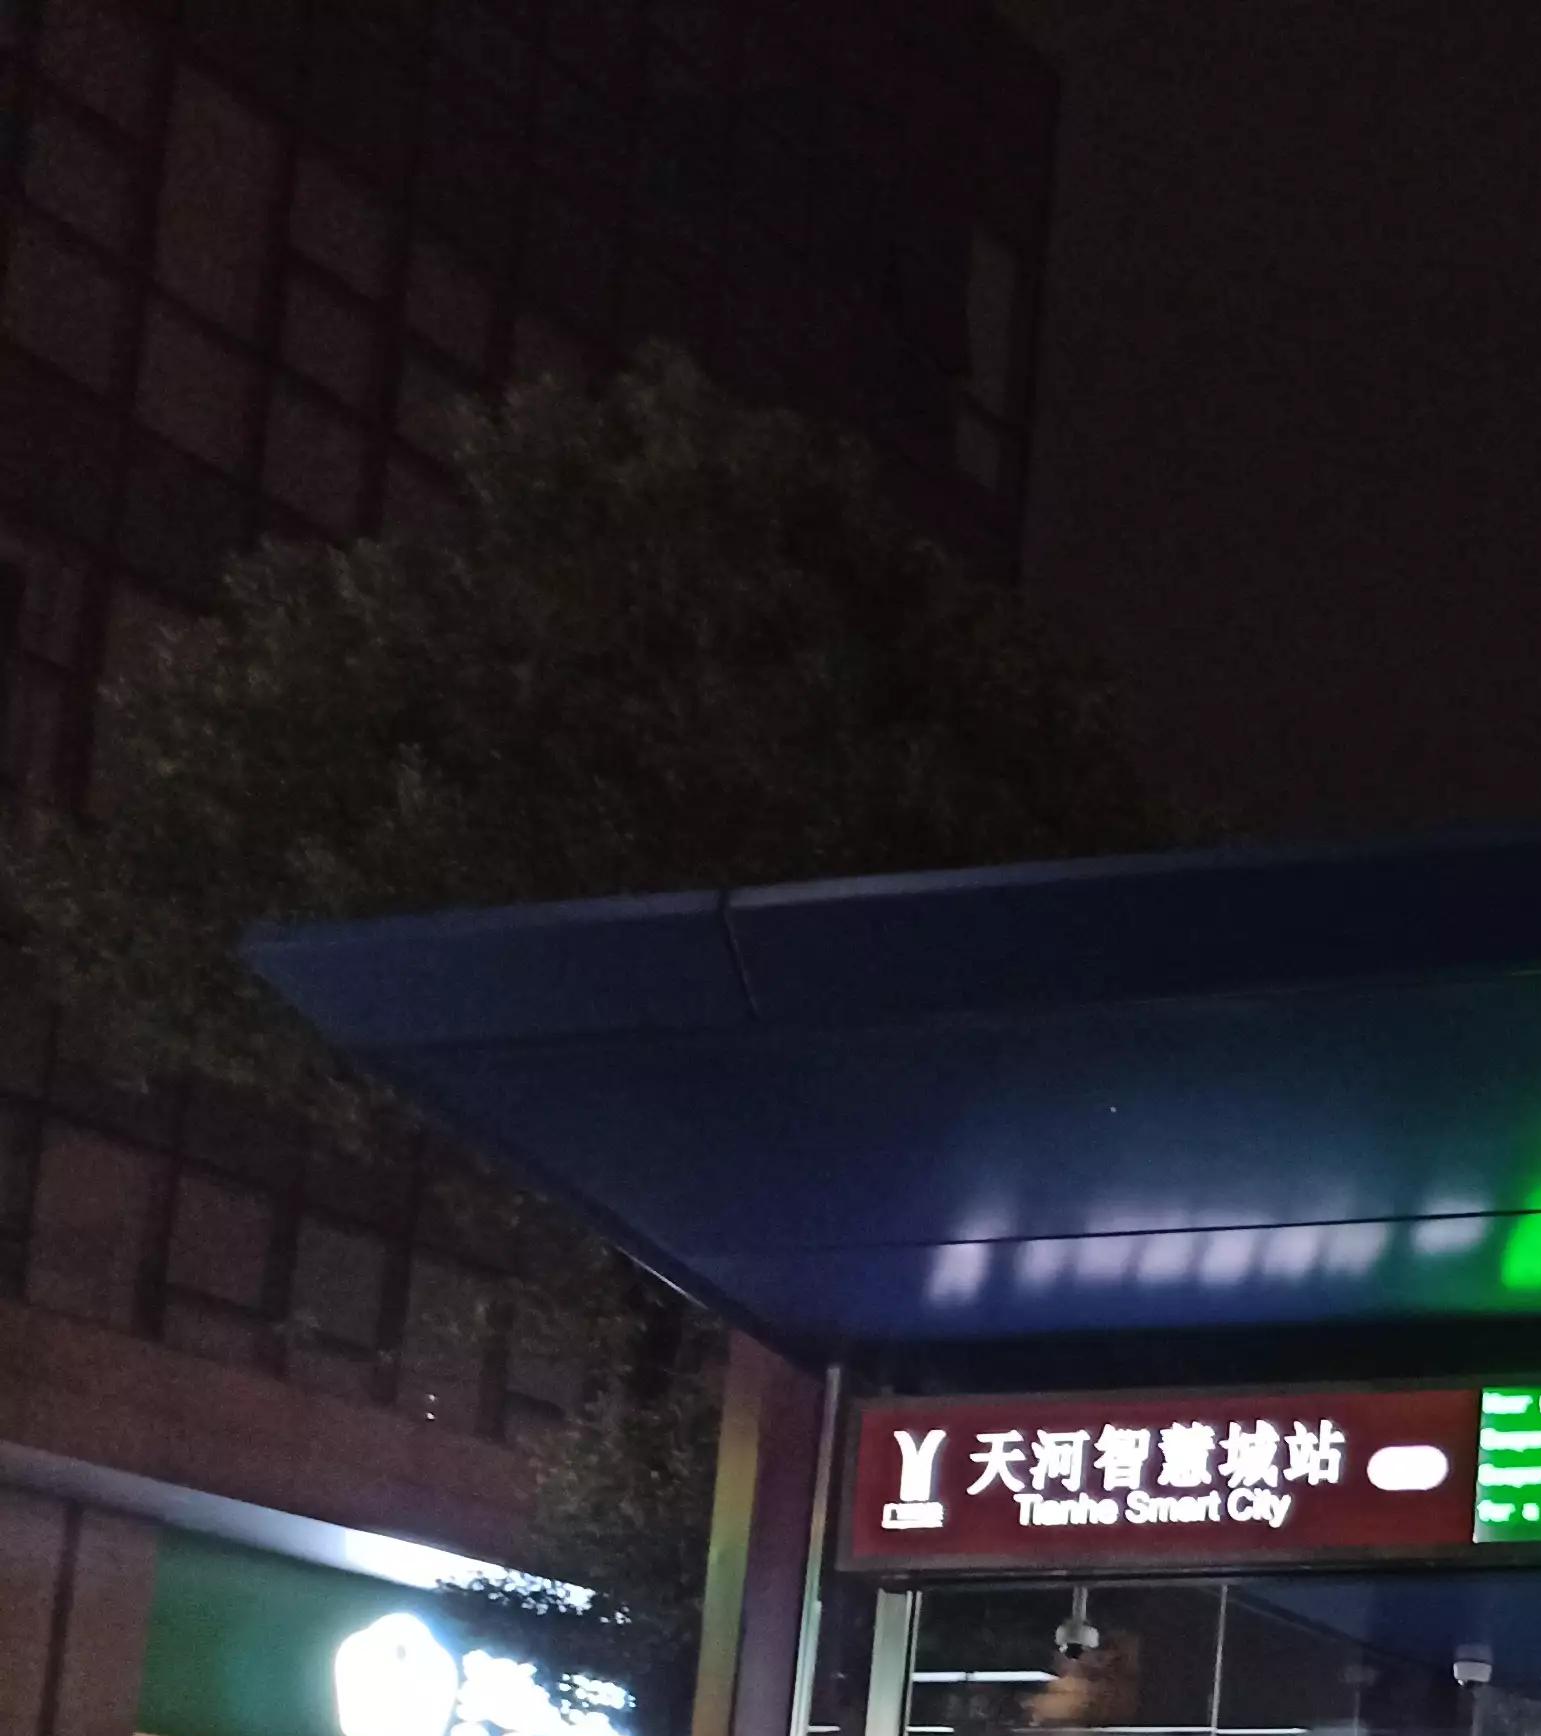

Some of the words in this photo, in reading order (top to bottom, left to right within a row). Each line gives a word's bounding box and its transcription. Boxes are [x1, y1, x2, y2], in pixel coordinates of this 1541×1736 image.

[966, 1420, 1346, 1495] 天河智慧城站
[1013, 1492, 1120, 1525] Tianhe
[1125, 1489, 1221, 1524] Smart
[1227, 1487, 1291, 1529] City
